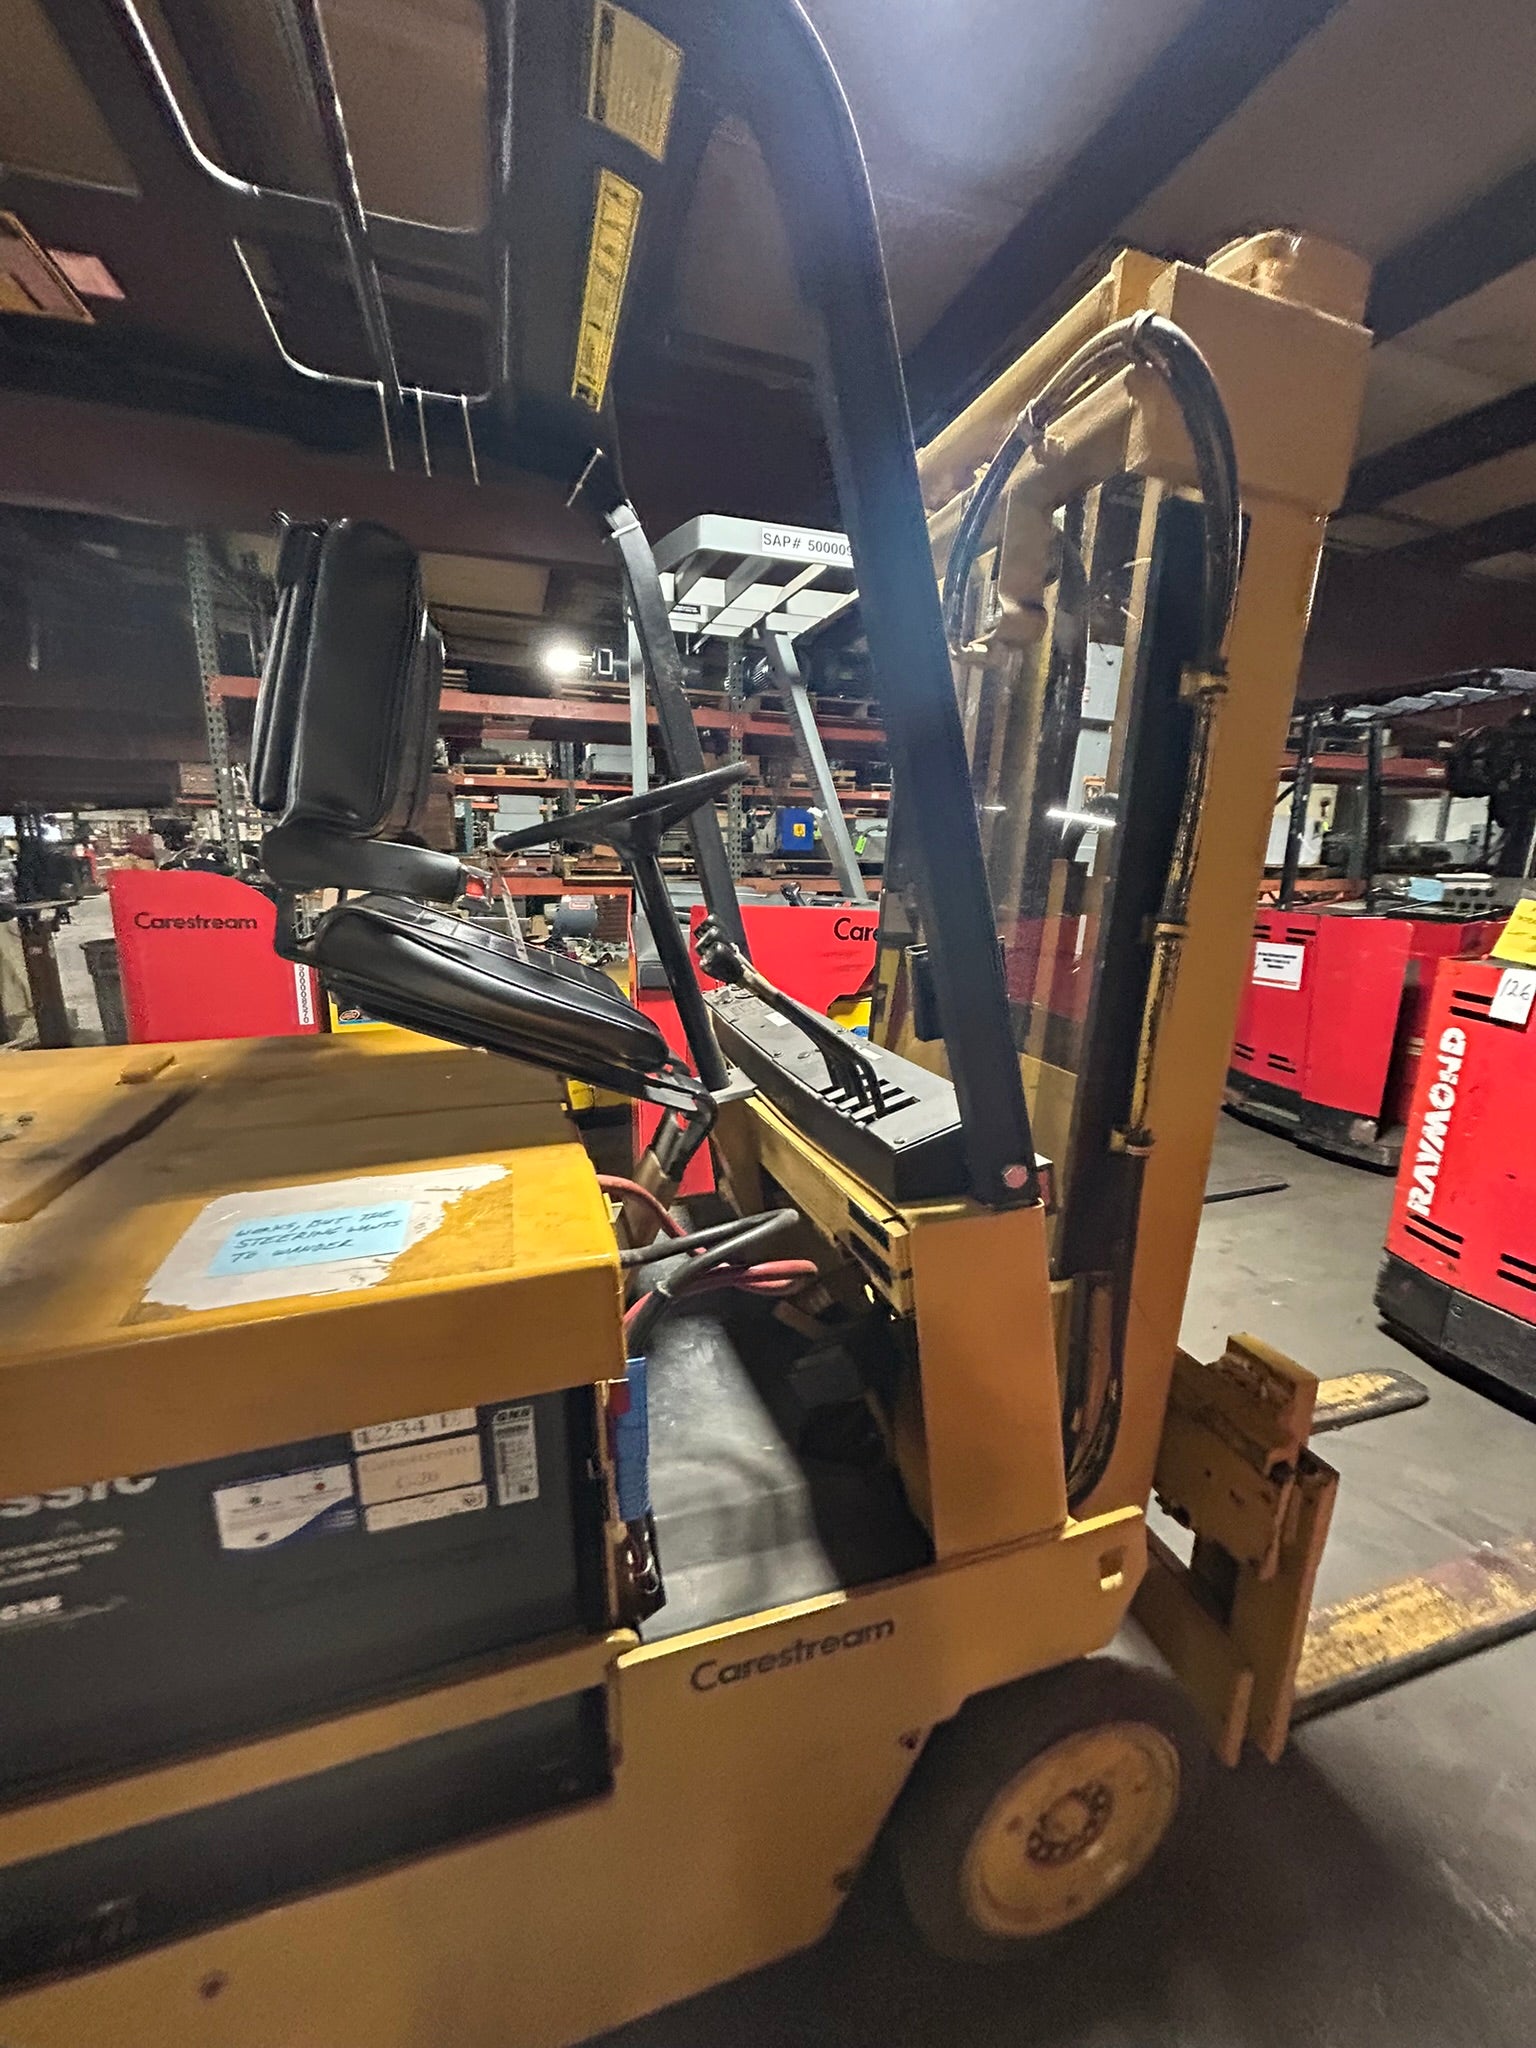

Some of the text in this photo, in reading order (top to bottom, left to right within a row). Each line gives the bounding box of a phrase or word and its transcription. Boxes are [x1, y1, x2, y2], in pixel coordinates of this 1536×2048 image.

[763, 533, 801, 549] SAP#
[134, 911, 258, 930] Carestream
[1500, 979, 1531, 1001] 126
[1407, 1027, 1467, 1217] RAYMOND
[306, 1216, 353, 1229] BUT
[359, 1210, 395, 1222] THE
[234, 1220, 402, 1249] STEERING WANTS
[232, 1239, 353, 1263] TO WANDER
[690, 1618, 896, 1692] Carestream
